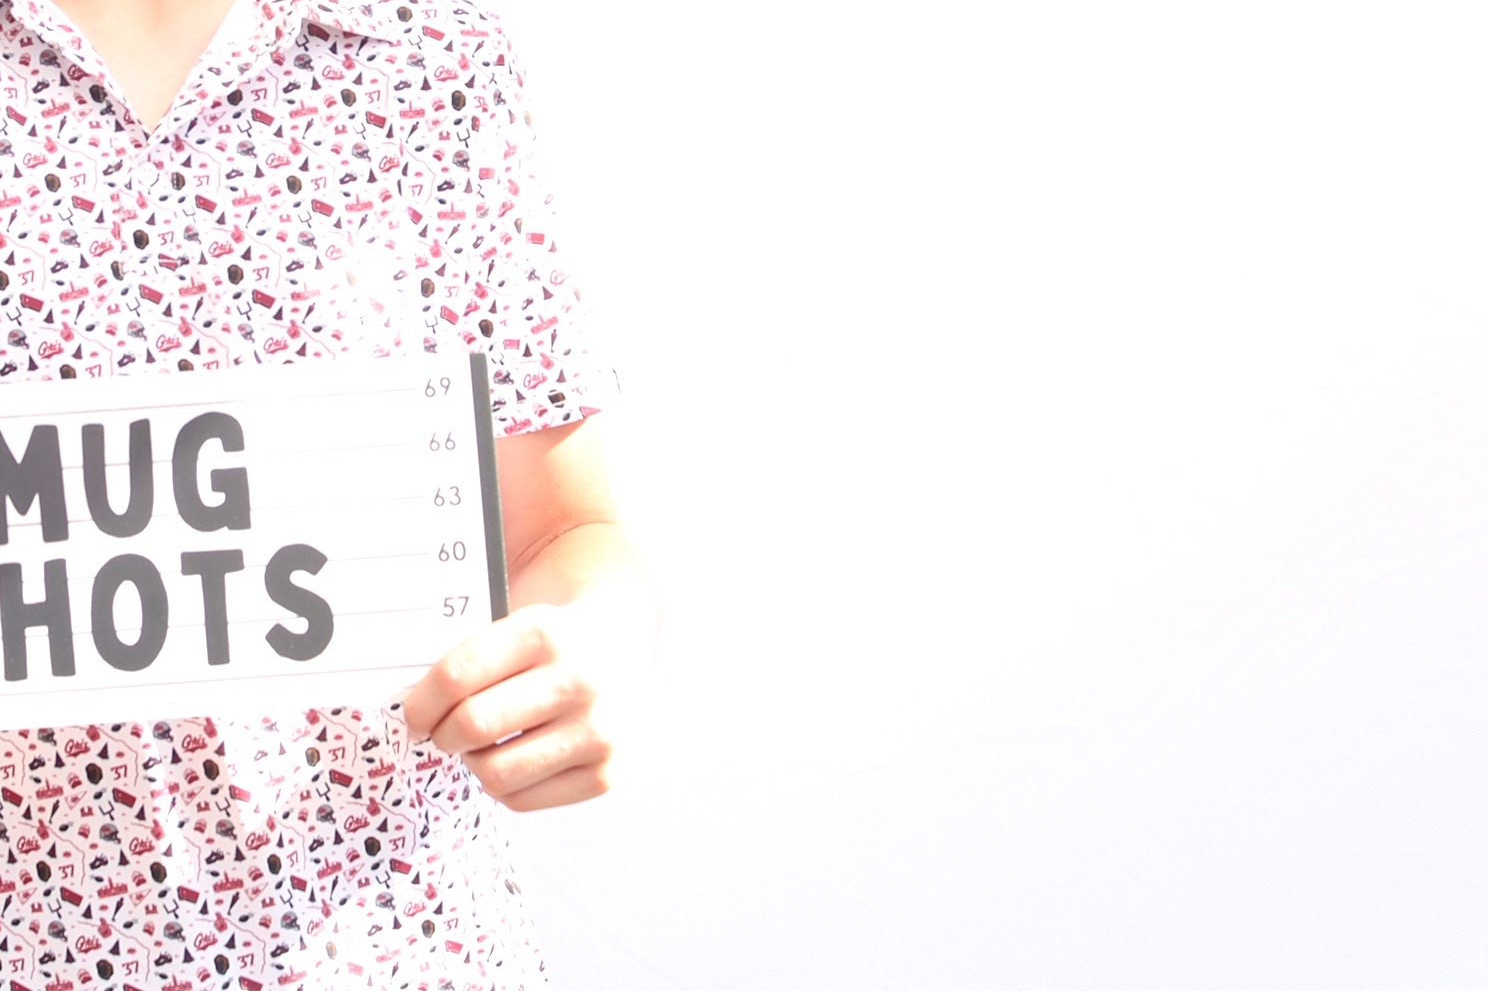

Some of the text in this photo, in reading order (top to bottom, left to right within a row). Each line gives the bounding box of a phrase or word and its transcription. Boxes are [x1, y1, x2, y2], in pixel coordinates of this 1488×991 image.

[422, 8, 438, 20] 37
[3, 86, 19, 100] 37
[249, 86, 269, 103] 37
[364, 88, 382, 105] 37
[69, 172, 88, 189] 37
[193, 173, 211, 189] 37
[310, 176, 328, 192] 37
[157, 229, 175, 247] 37
[16, 268, 36, 287] 37
[252, 265, 271, 283] 37
[85, 363, 103, 379] 37
[424, 376, 451, 398] 69
[429, 431, 456, 452] 66
[433, 485, 462, 507] 63
[438, 540, 467, 562] 60
[442, 595, 470, 618] 57
[328, 745, 347, 763] 37
[0, 762, 17, 781] 37
[111, 762, 129, 781] 37
[387, 834, 407, 852] 37
[286, 849, 300, 869] 37
[58, 862, 76, 881] 37
[443, 917, 460, 931] 37
[9, 956, 27, 974] 37
[122, 959, 141, 977] 37
[237, 951, 257, 970] 37
